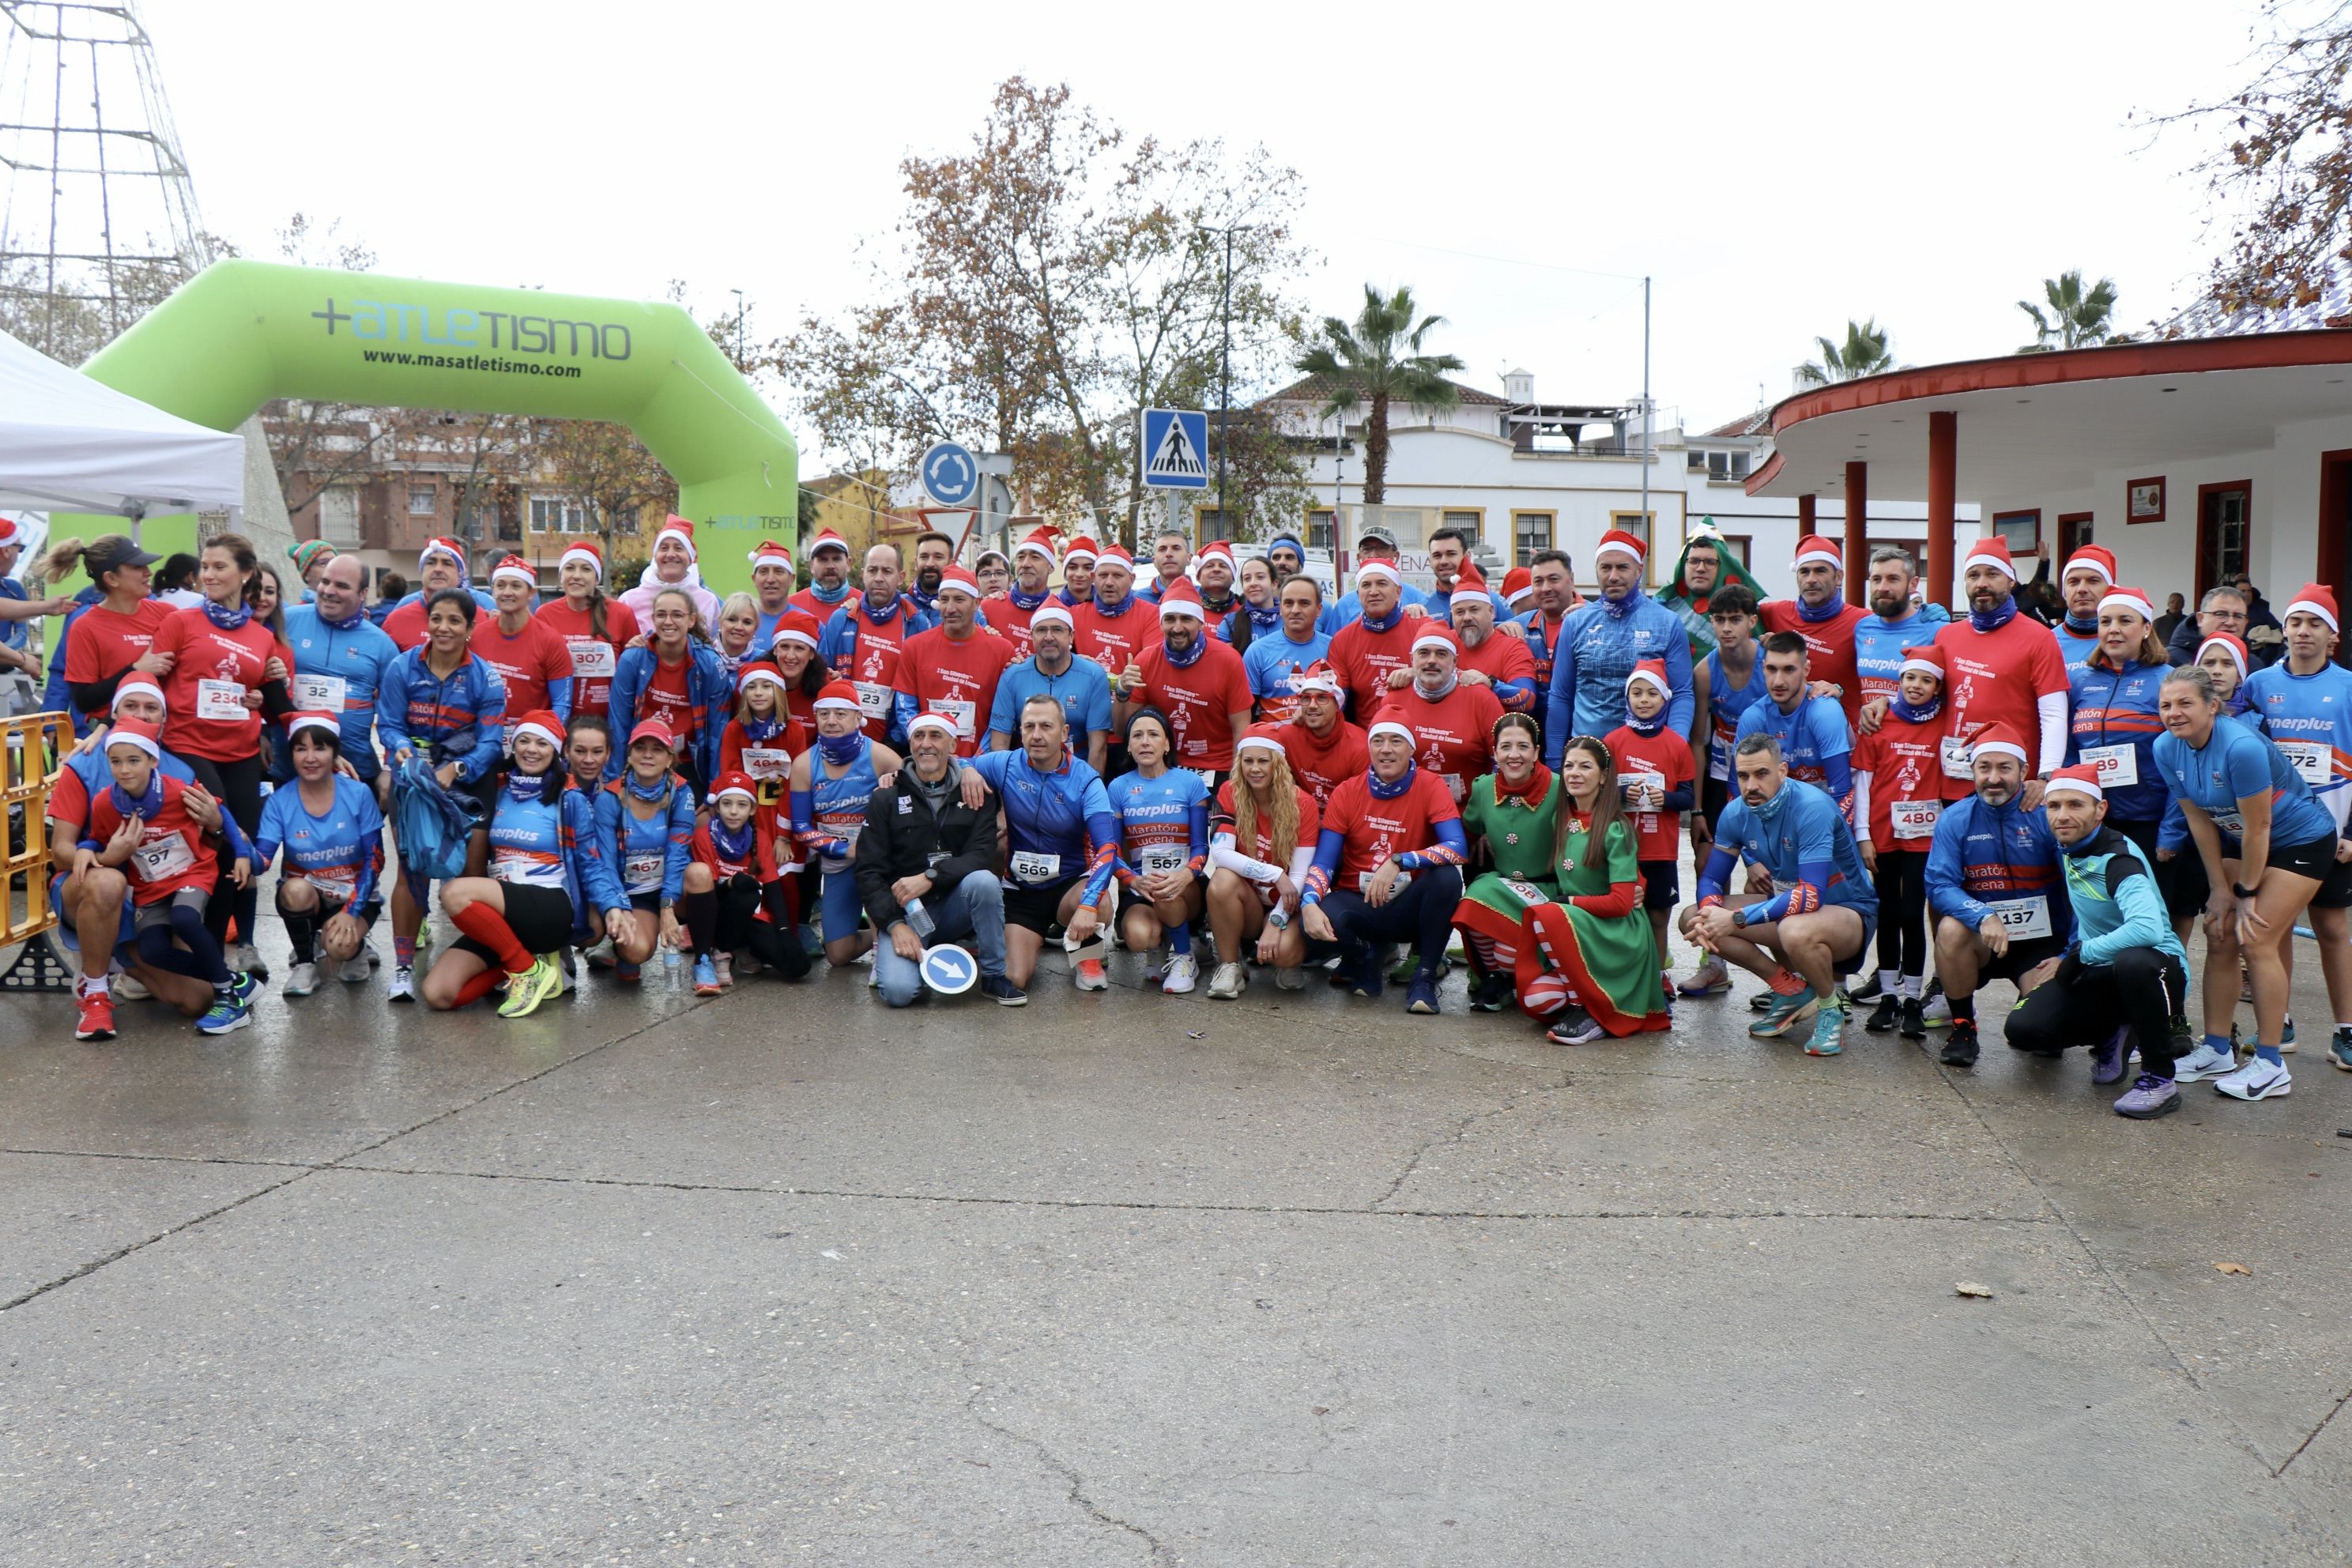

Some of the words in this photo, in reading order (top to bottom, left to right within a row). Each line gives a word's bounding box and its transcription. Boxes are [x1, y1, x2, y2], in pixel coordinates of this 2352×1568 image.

[363, 349, 582, 378] www.masatletismo.com
[1398, 555, 1432, 571] ENA
[576, 654, 605, 664] 307
[1857, 657, 1903, 672] enerplu
[308, 686, 328, 697] 32
[1860, 678, 1901, 692] Maratón
[211, 692, 238, 705] 234
[861, 693, 880, 705] 23
[2072, 722, 2094, 733] cena
[1947, 750, 1972, 763] 41
[753, 759, 782, 769] 464
[1123, 803, 1183, 818] enerplus
[1902, 811, 1936, 824] 480
[1128, 823, 1179, 836] Maratón
[1136, 835, 1175, 847] Lucena
[149, 848, 170, 866] 97
[296, 844, 356, 862] enerplus
[631, 860, 661, 873] 467
[1020, 863, 1050, 876] 569
[1152, 858, 1182, 870] 567
[2003, 910, 2034, 925] 137
